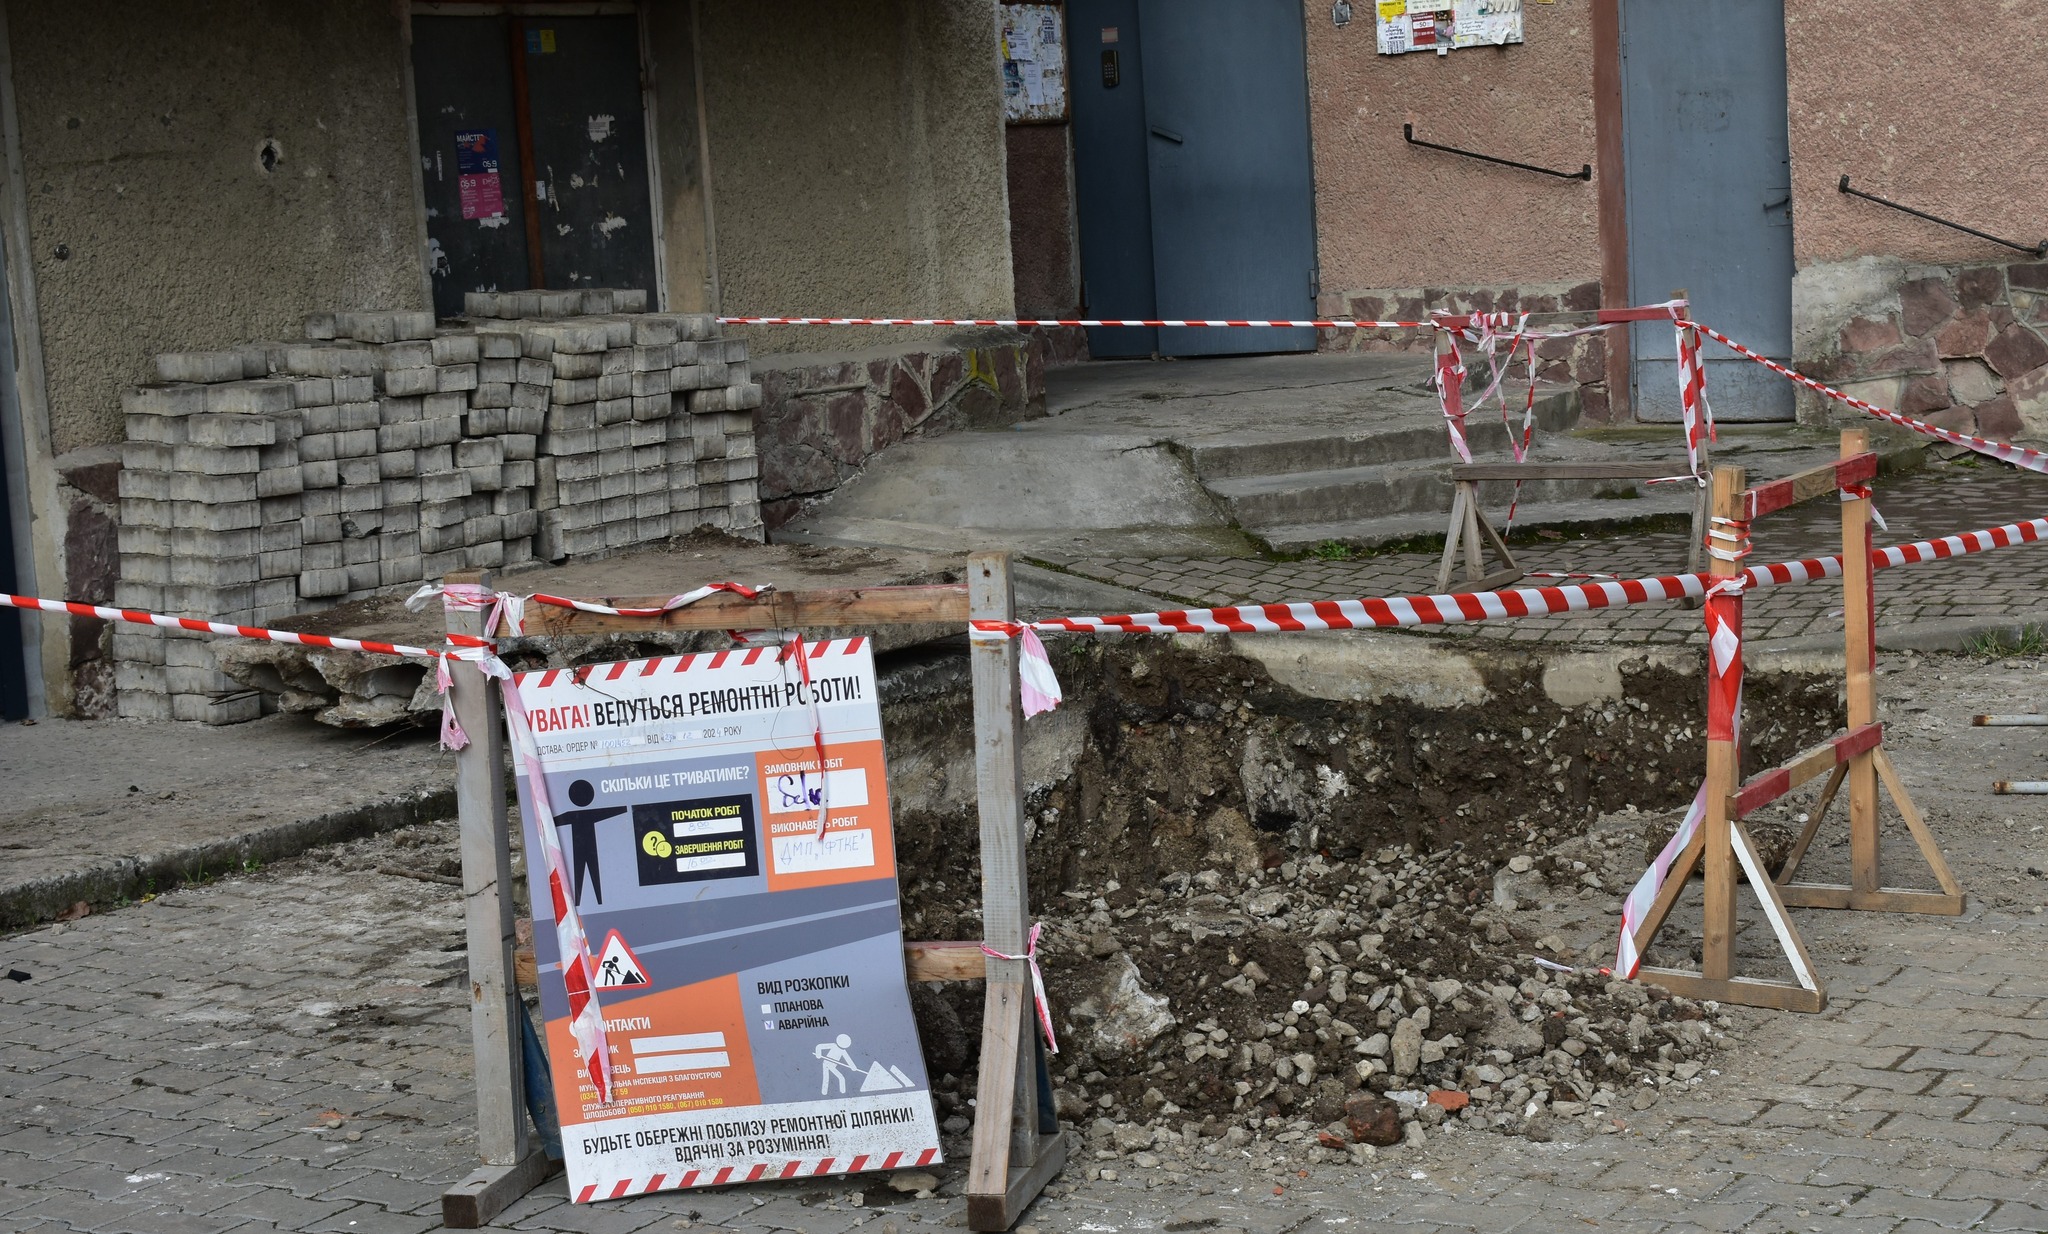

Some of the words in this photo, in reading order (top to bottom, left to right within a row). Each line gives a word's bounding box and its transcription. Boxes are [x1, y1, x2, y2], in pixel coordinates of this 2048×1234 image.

[525, 704, 590, 733] УВАГА!
[594, 694, 684, 727] ВЕДУТЬСЯ
[689, 684, 780, 716] РЕМОНТНІ
[785, 676, 861, 706] РОБОТИ!
[537, 746, 564, 756] ДСТАВА:
[566, 742, 589, 753] ОРДЕР
[647, 734, 659, 744] ВІД
[724, 726, 742, 737] РОКУ
[765, 761, 815, 775] ЗАМОВНИК
[601, 775, 652, 793] СКІЛЬКИ
[654, 774, 670, 789] ЦЕ
[672, 766, 750, 786] ТРИВАТИМЕ?
[671, 807, 713, 820] ПОЧАТОК
[715, 805, 741, 817] РОБІТ
[771, 820, 831, 833] ВИКОНАВЕЬ
[832, 816, 858, 828] РОБІТ
[675, 841, 723, 855] ЗАВЕРШЕННЯ
[724, 840, 744, 851] РОБІТ
[757, 981, 783, 995] ВИД
[785, 975, 850, 992] РОЗКОПКИ
[774, 999, 824, 1013] ПЛАНОВА
[604, 1017, 651, 1032] НТАКТИ
[778, 1015, 830, 1030] АВАРІЙНА
[577, 1064, 631, 1078] ВИВЕЦЬ
[633, 1075, 667, 1086] ІНСПЕКЦІЯ
[674, 1071, 722, 1081] БЛАГОУСТРОЮ
[611, 1095, 661, 1107] ОПЕРАТИВНОГО
[663, 1091, 705, 1102] РЕАГУВАННЯ
[620, 1088, 629, 1096] 59
[584, 1108, 626, 1120] ЦІЛОДОБОВО
[583, 1133, 632, 1155] БУДЬТЕ
[635, 1126, 703, 1148] ОБЕРЕЖНІ
[706, 1120, 766, 1140] ПОБЛИЗУ
[771, 1110, 847, 1134] РЕМОНТНОЇ
[851, 1107, 915, 1129] ДІЛЯНКИ!
[675, 1142, 724, 1163] ВДЯЧНІ
[728, 1141, 745, 1157] ЗА
[748, 1134, 830, 1155] РОЗУМІННЯ!
